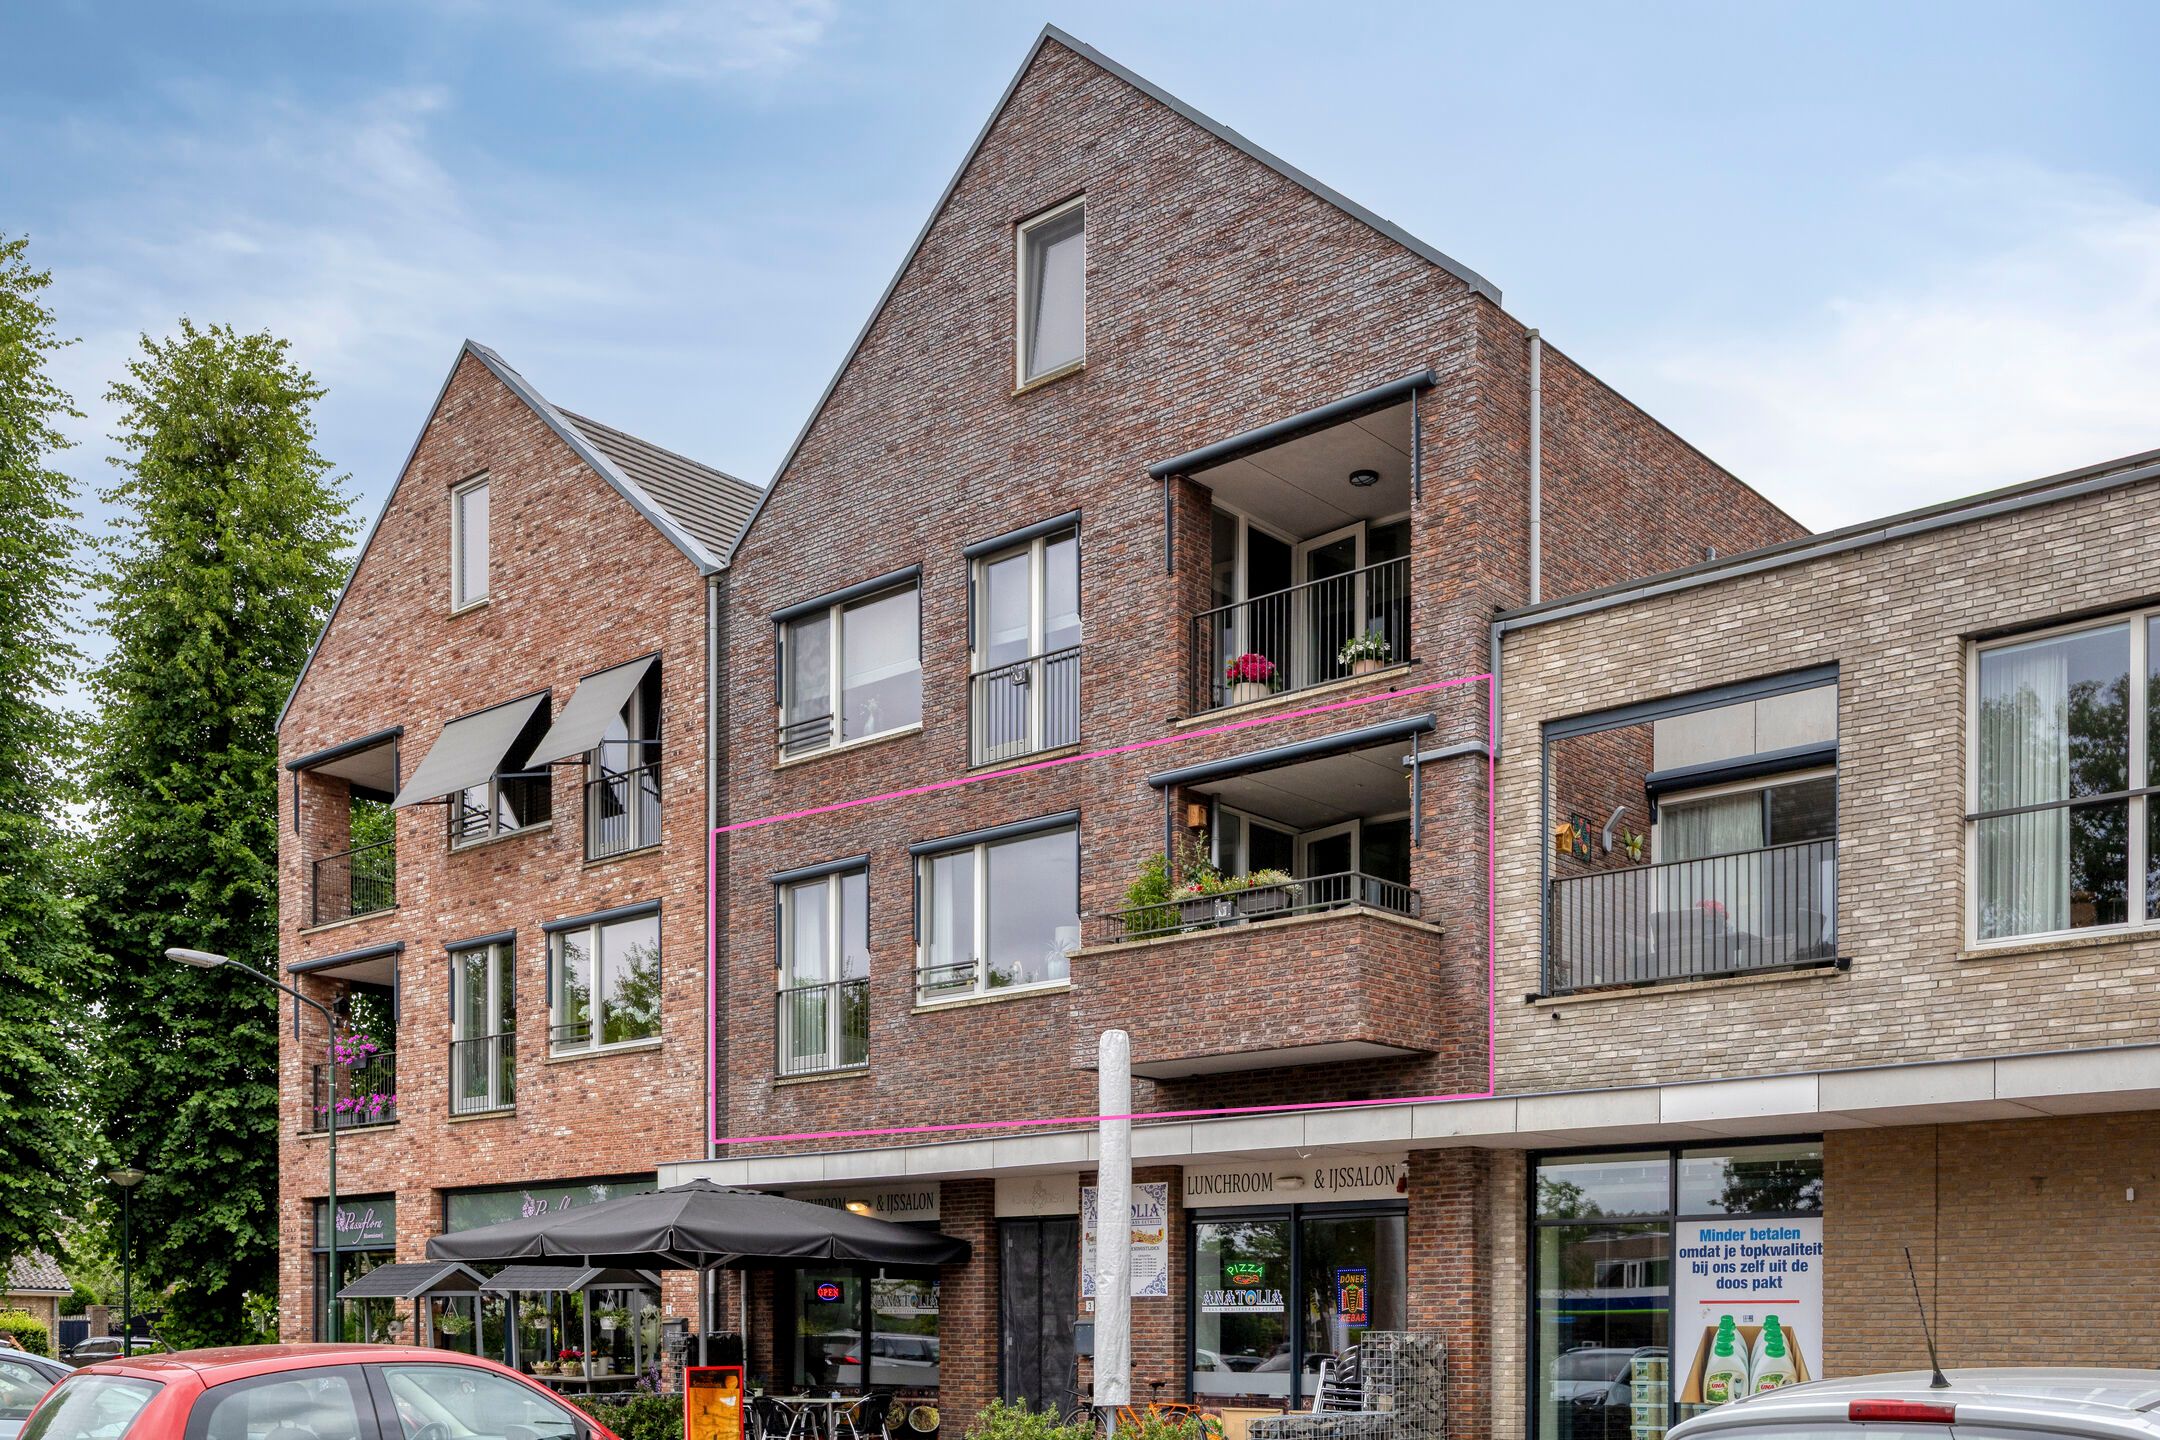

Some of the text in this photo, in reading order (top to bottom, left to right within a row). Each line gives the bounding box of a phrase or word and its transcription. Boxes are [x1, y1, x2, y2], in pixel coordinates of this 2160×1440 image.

[1187, 1164, 1396, 1195] LUNCHROOM & IJSSALON
[876, 1192, 934, 1215] & IJSSALON
[345, 1208, 384, 1244] Passiflora
[1699, 1227, 1801, 1242] Minder betalen
[1679, 1242, 1823, 1260] omdat je topkwaliteit
[1227, 1263, 1263, 1277] PIZZA
[1692, 1259, 1808, 1276] bij ons zelf uit de
[1716, 1276, 1783, 1291] doos pakt
[817, 1287, 839, 1297] OPEN
[1202, 1289, 1285, 1306] ANATOLIA
[876, 1294, 939, 1309] ANATOLIA
[1340, 1313, 1366, 1323] KEBAB
